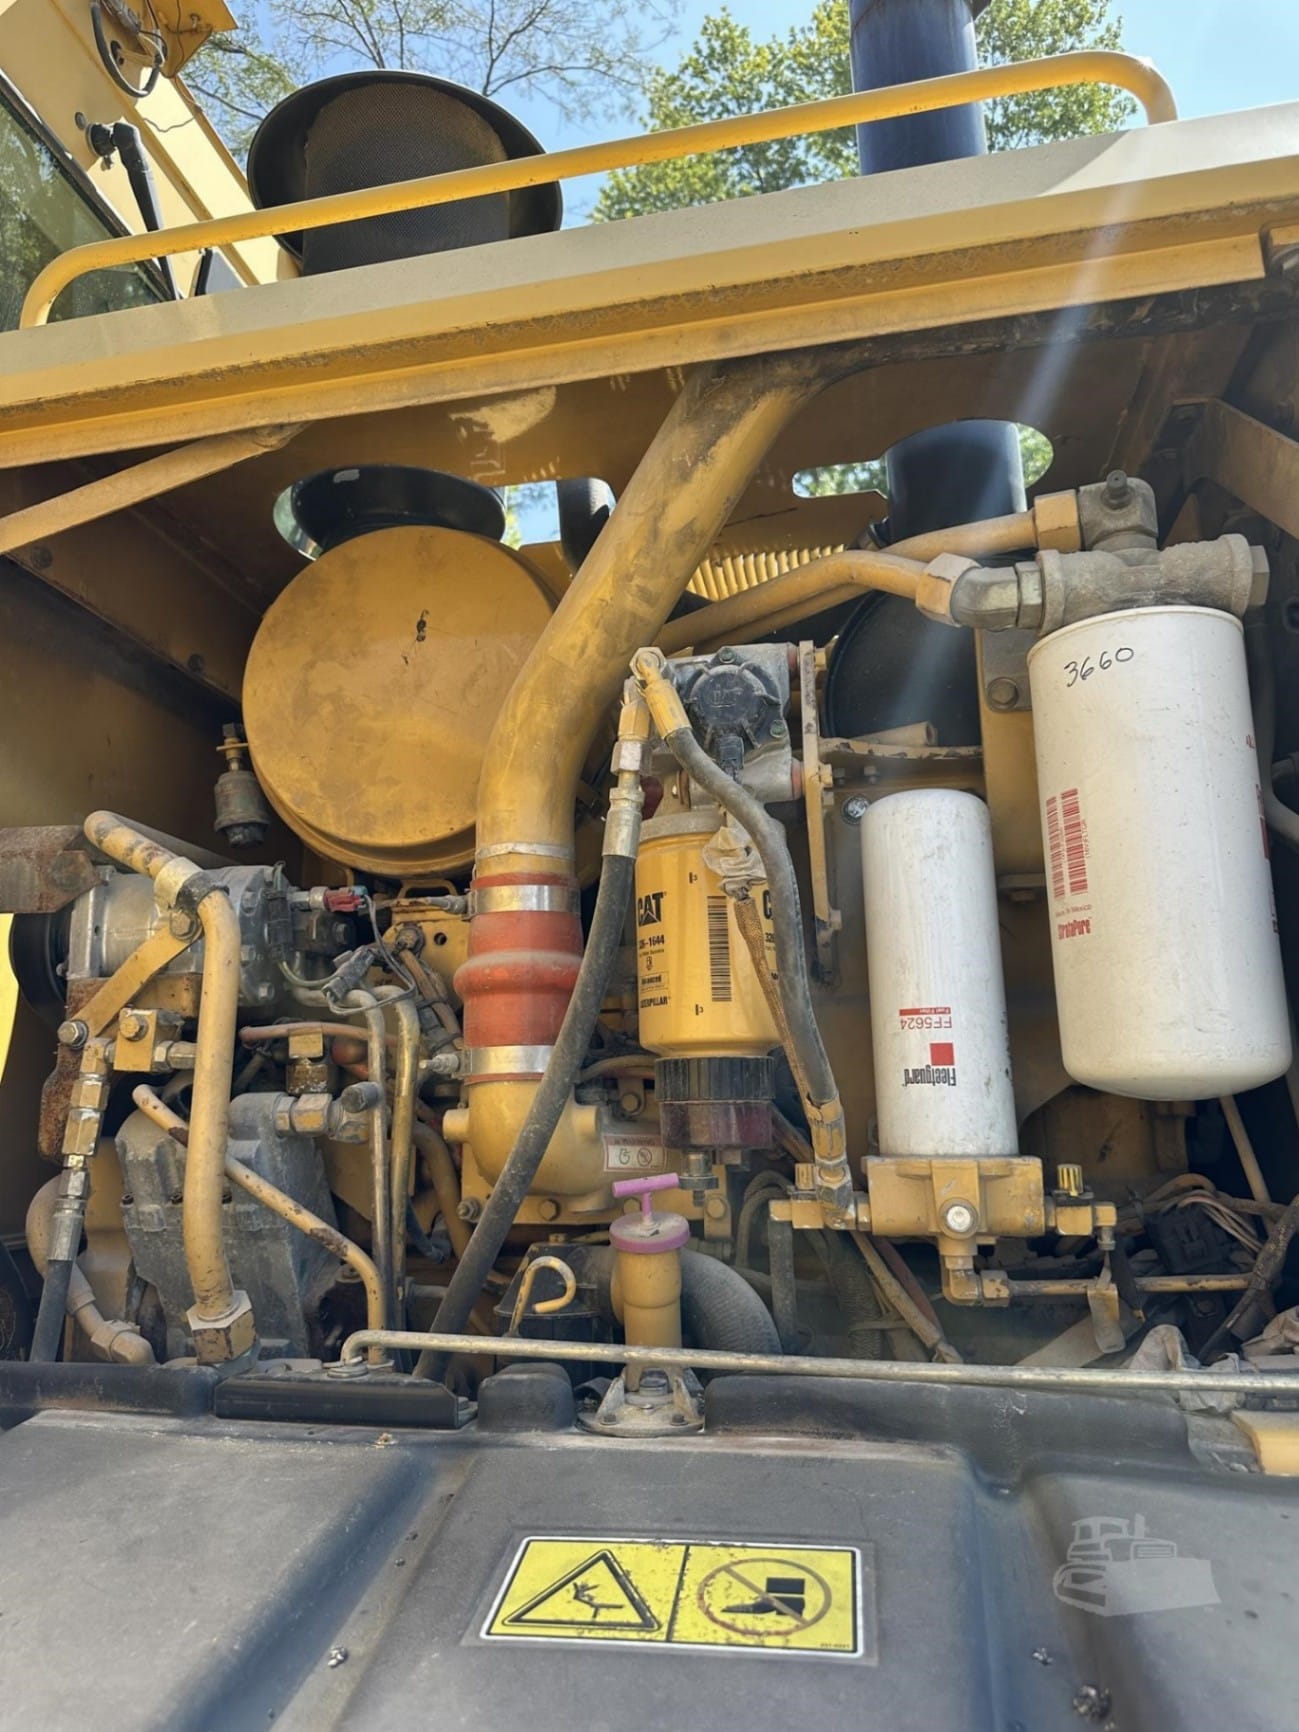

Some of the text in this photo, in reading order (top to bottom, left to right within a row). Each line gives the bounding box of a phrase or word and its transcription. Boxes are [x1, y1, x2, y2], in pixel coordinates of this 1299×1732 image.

[1063, 647, 1134, 687] 3660
[900, 1016, 953, 1030] FF5624
[903, 1064, 957, 1087] Fleetguard
